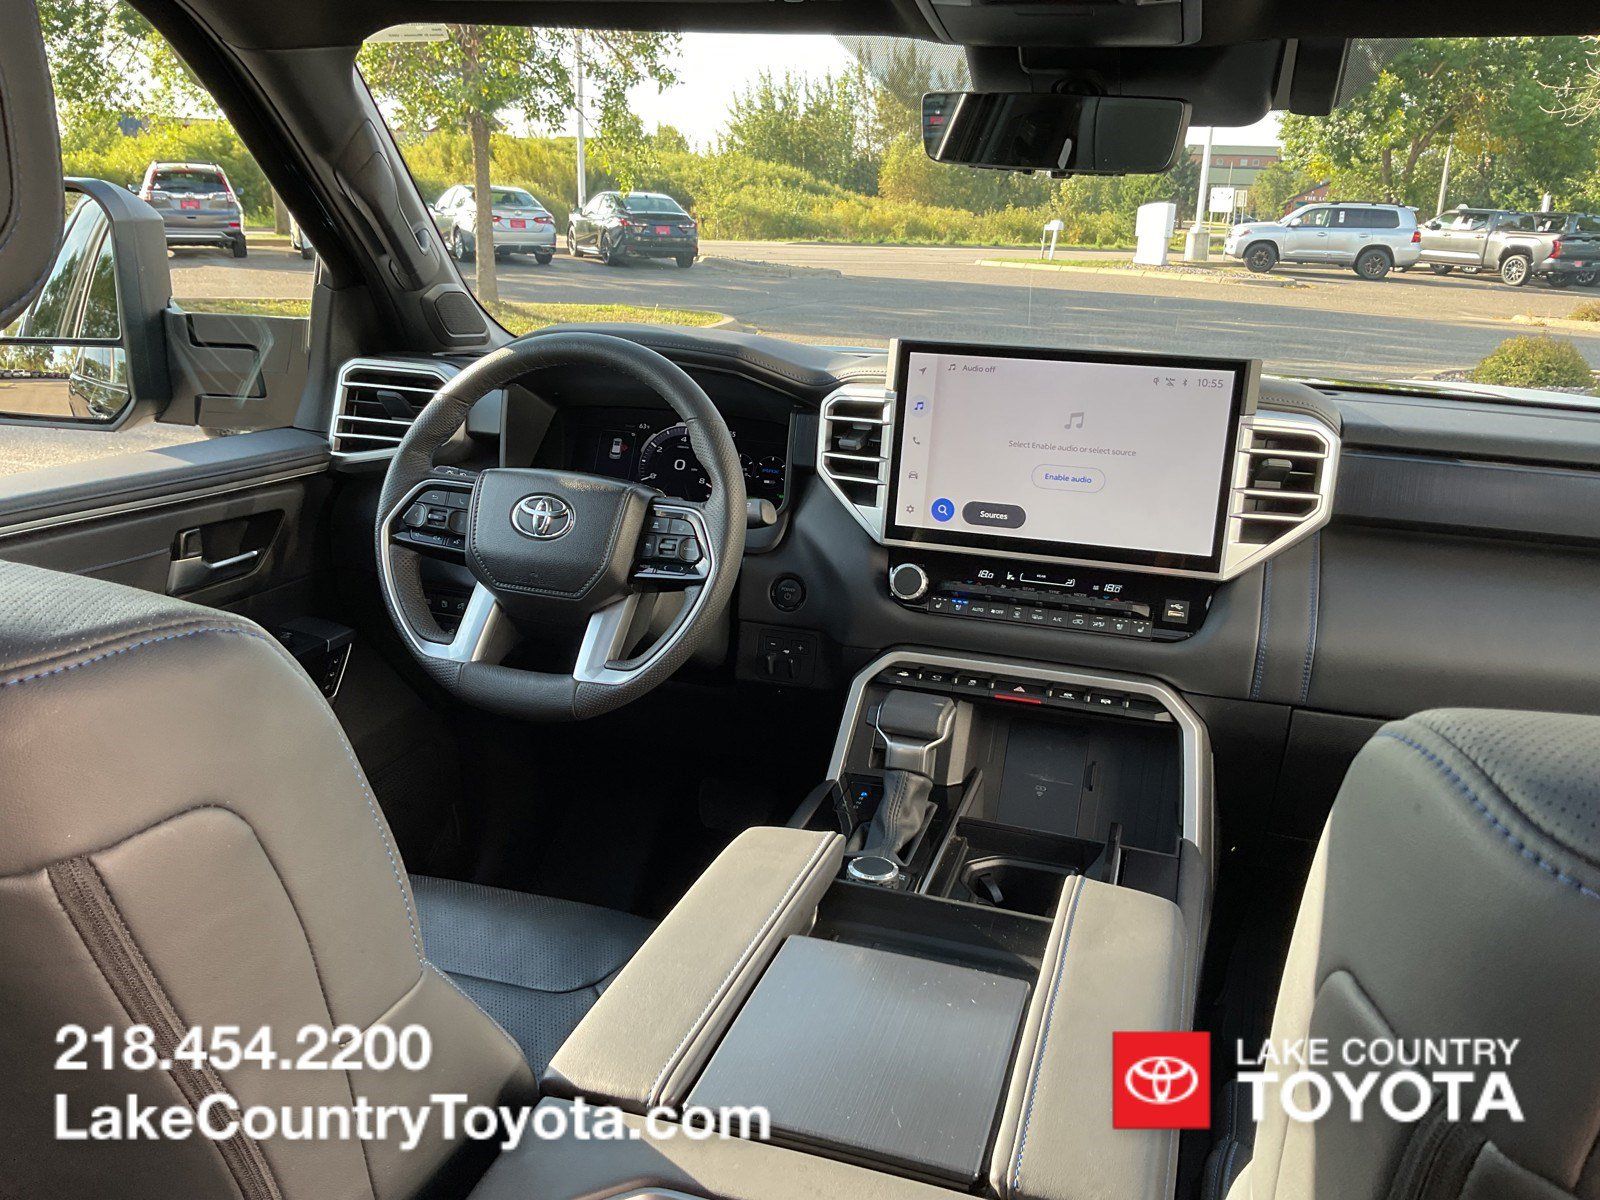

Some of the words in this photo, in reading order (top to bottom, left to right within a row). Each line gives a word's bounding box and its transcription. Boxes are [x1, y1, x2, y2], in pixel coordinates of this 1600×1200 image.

[962, 364, 984, 373] Audio
[1198, 378, 1224, 389] 10:55
[1008, 440, 1031, 449] Select
[1031, 442, 1057, 451] Enable
[1057, 444, 1079, 453] audio
[1088, 447, 1111, 455] select
[674, 459, 686, 470] 0
[1044, 473, 1070, 482] Enable
[1070, 475, 1092, 484] audio
[979, 510, 1008, 520] Sources
